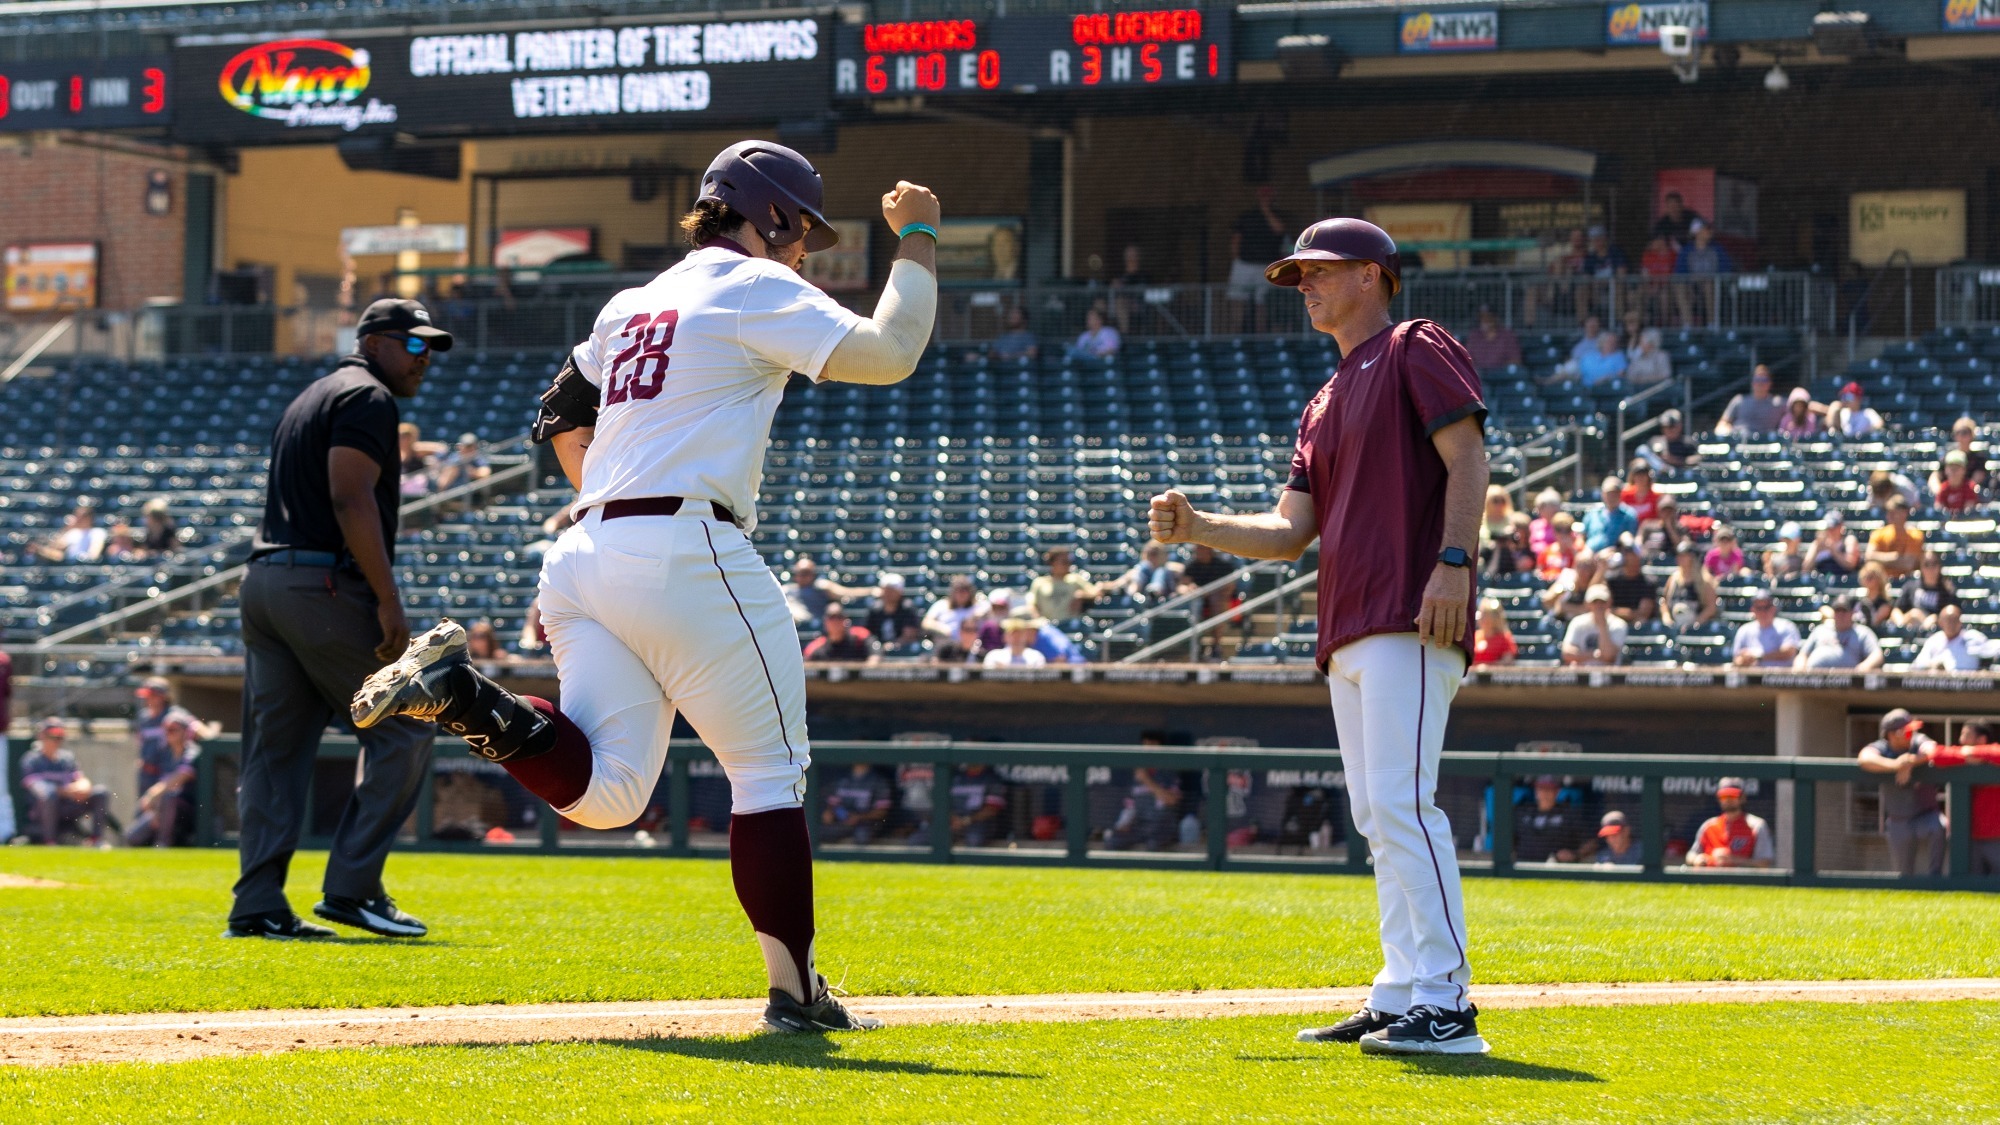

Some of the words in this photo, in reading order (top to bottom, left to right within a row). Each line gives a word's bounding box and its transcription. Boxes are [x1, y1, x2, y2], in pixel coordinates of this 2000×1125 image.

[410, 35, 513, 77] OFFICIAL
[515, 28, 616, 72] PRINTER
[617, 26, 651, 68] OF
[652, 24, 702, 66] THE
[702, 18, 818, 64] IRONPIGS
[1433, 15, 1494, 38] NEWS
[836, 58, 857, 93] R
[866, 55, 887, 93] 6
[896, 55, 916, 91] H
[916, 52, 946, 91] 10
[959, 52, 977, 88] E
[978, 50, 1000, 89] 0
[1051, 50, 1071, 85] R
[1082, 46, 1102, 85] 3
[1111, 47, 1132, 82] H
[1177, 44, 1196, 80] E
[11, 80, 57, 111] OUT
[142, 67, 165, 114] 3
[511, 73, 620, 118] VETERAN
[621, 70, 711, 113] OWNED
[606, 309, 679, 406] 28
